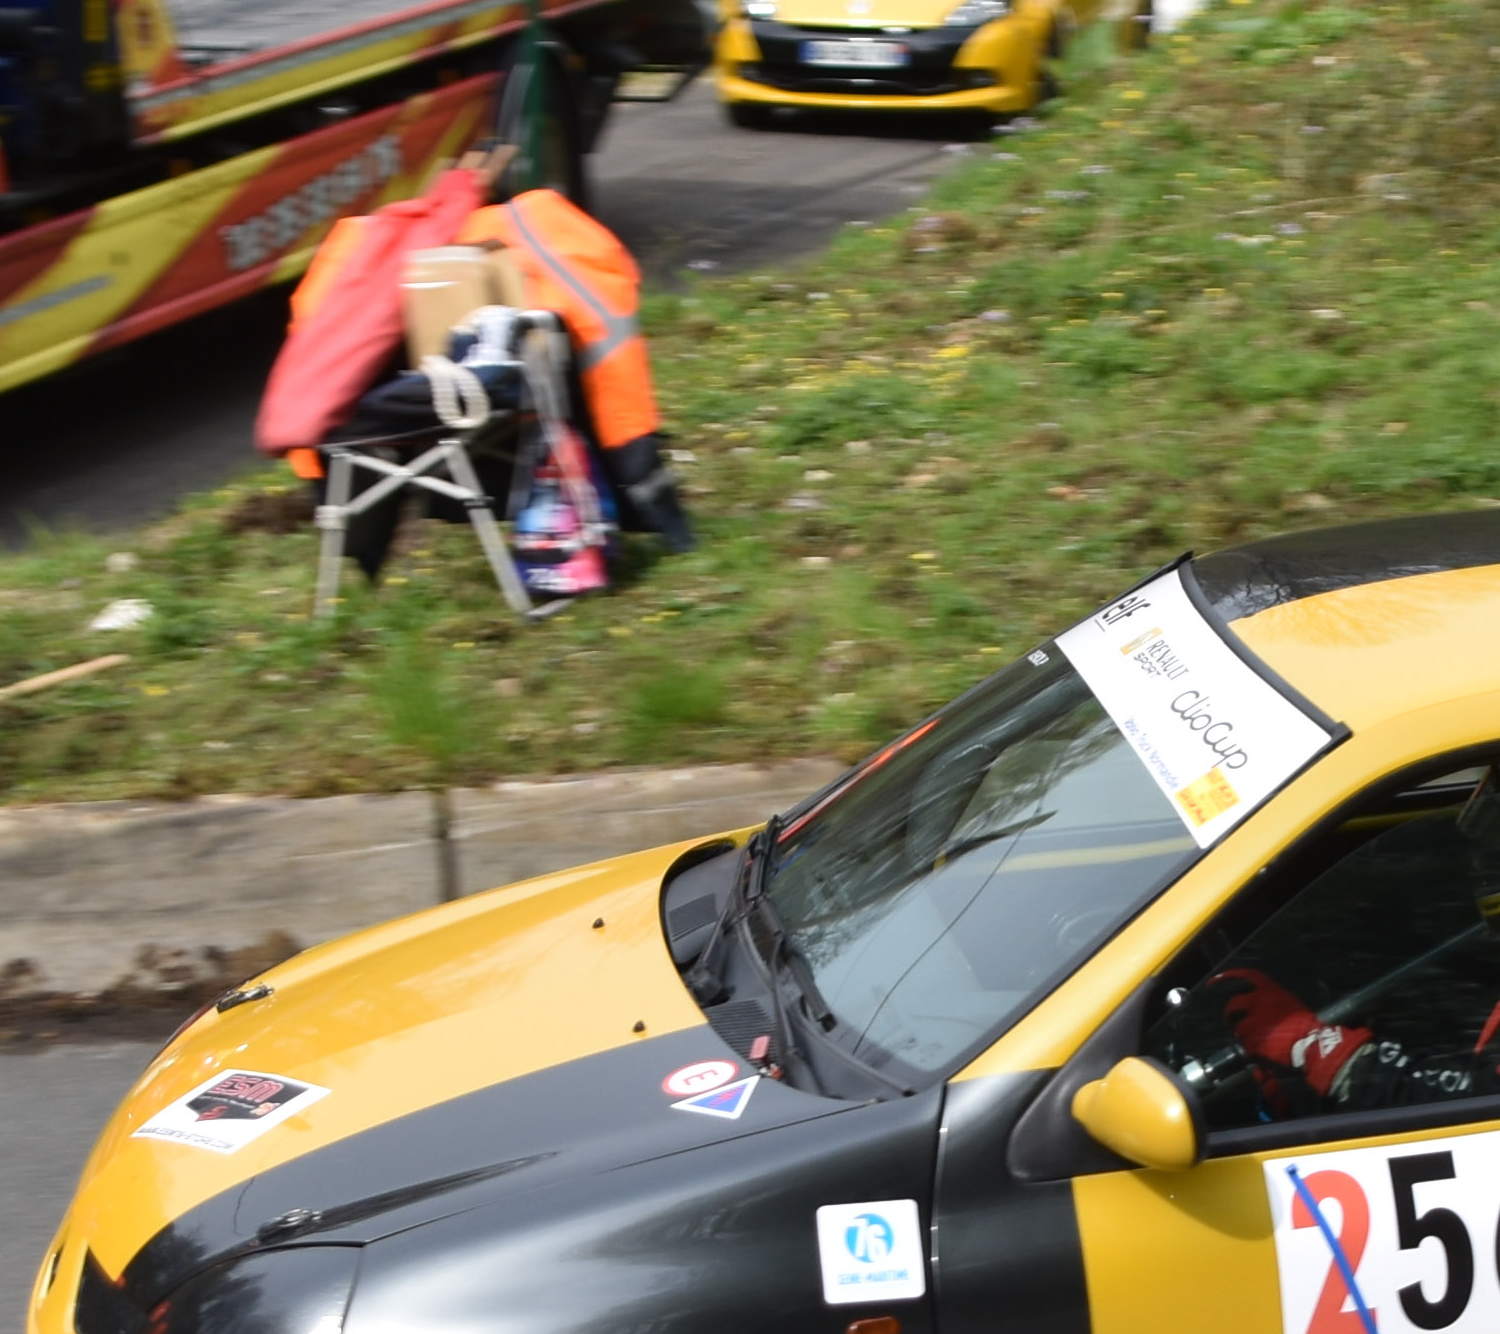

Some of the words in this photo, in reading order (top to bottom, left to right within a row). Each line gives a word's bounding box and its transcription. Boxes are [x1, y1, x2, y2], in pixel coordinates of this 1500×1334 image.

[1133, 652, 1161, 678] SPORT
[1146, 639, 1189, 680] RENAULT
[846, 1217, 892, 1264] 76
